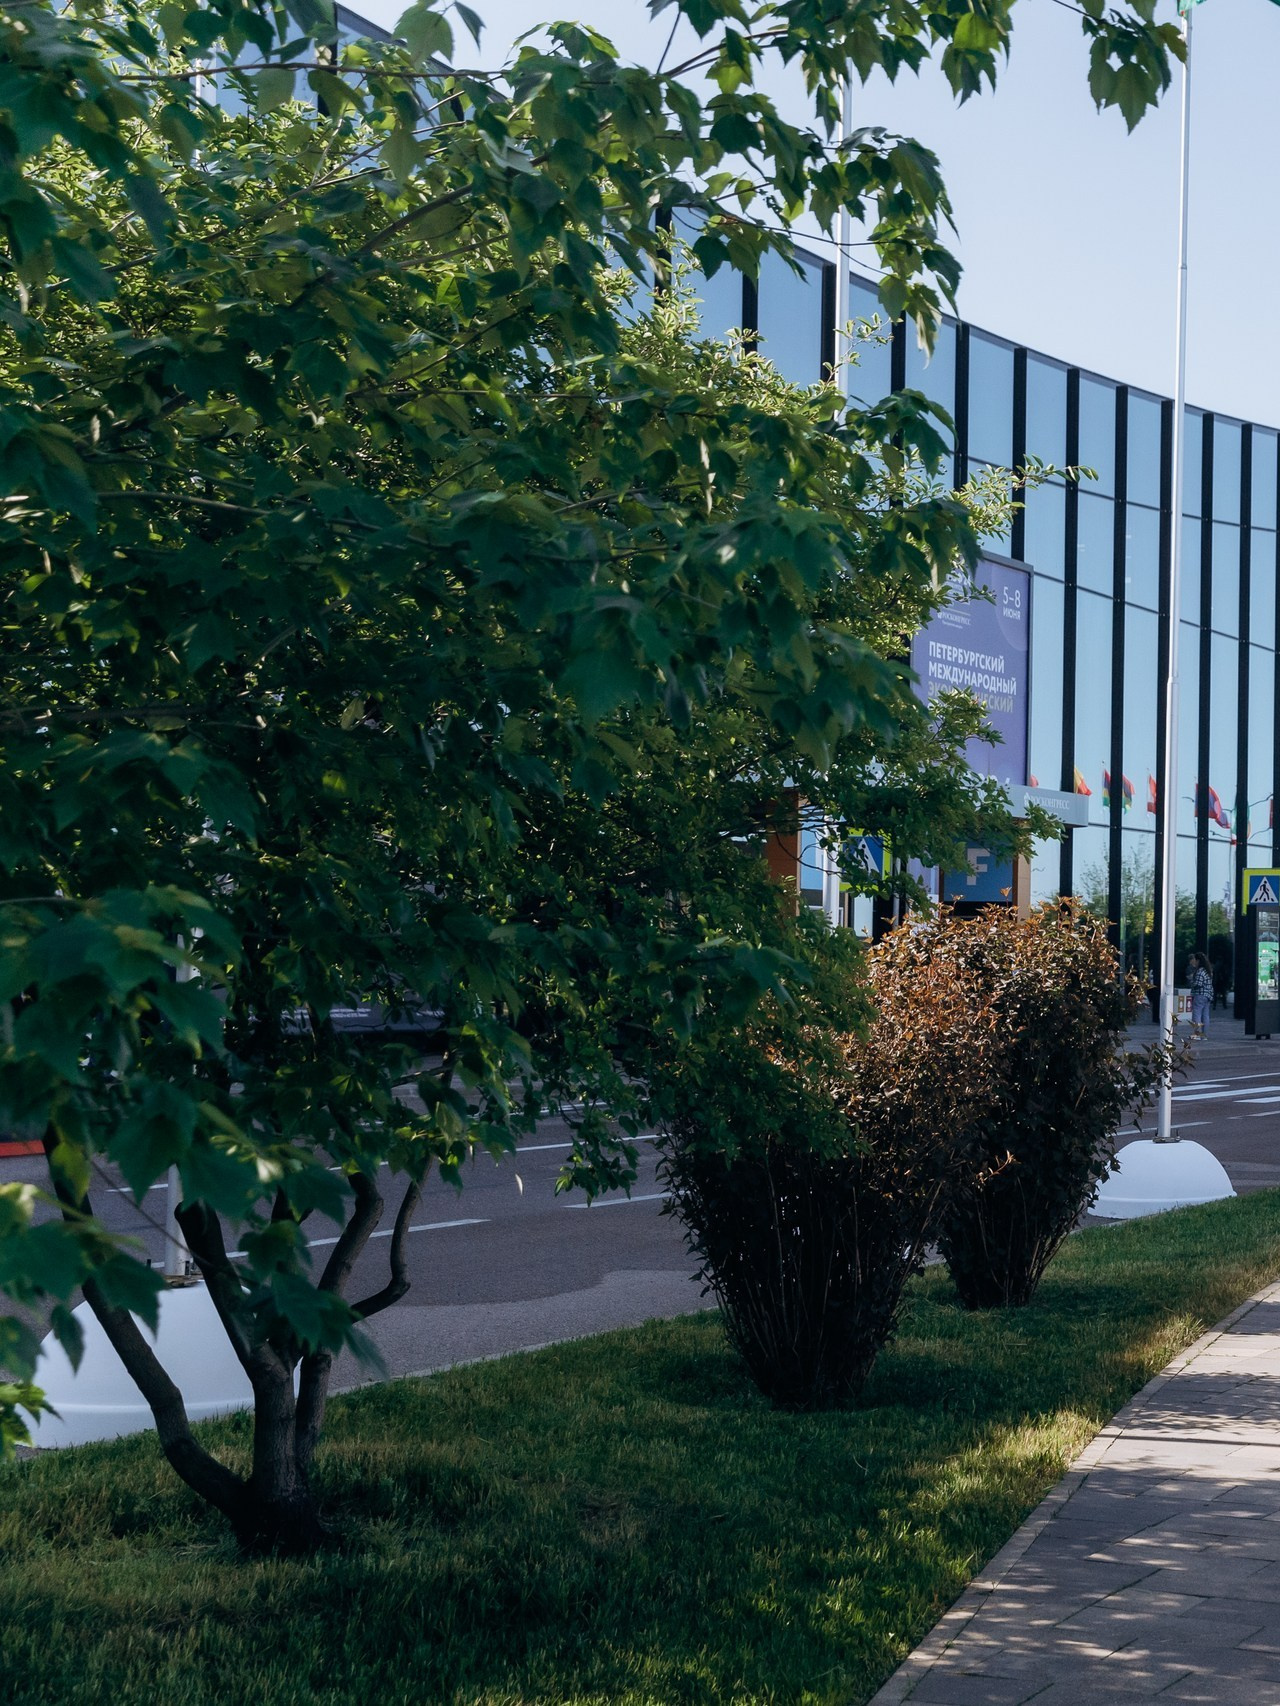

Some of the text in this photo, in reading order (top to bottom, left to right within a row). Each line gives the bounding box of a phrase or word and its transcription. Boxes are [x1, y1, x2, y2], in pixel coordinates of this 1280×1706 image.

[929, 640, 1005, 674] ПЕТЕРБУРГСКИЙ
[928, 661, 1017, 695] МЕЖДУНАРОДНЫЙ
[966, 848, 991, 885] F
